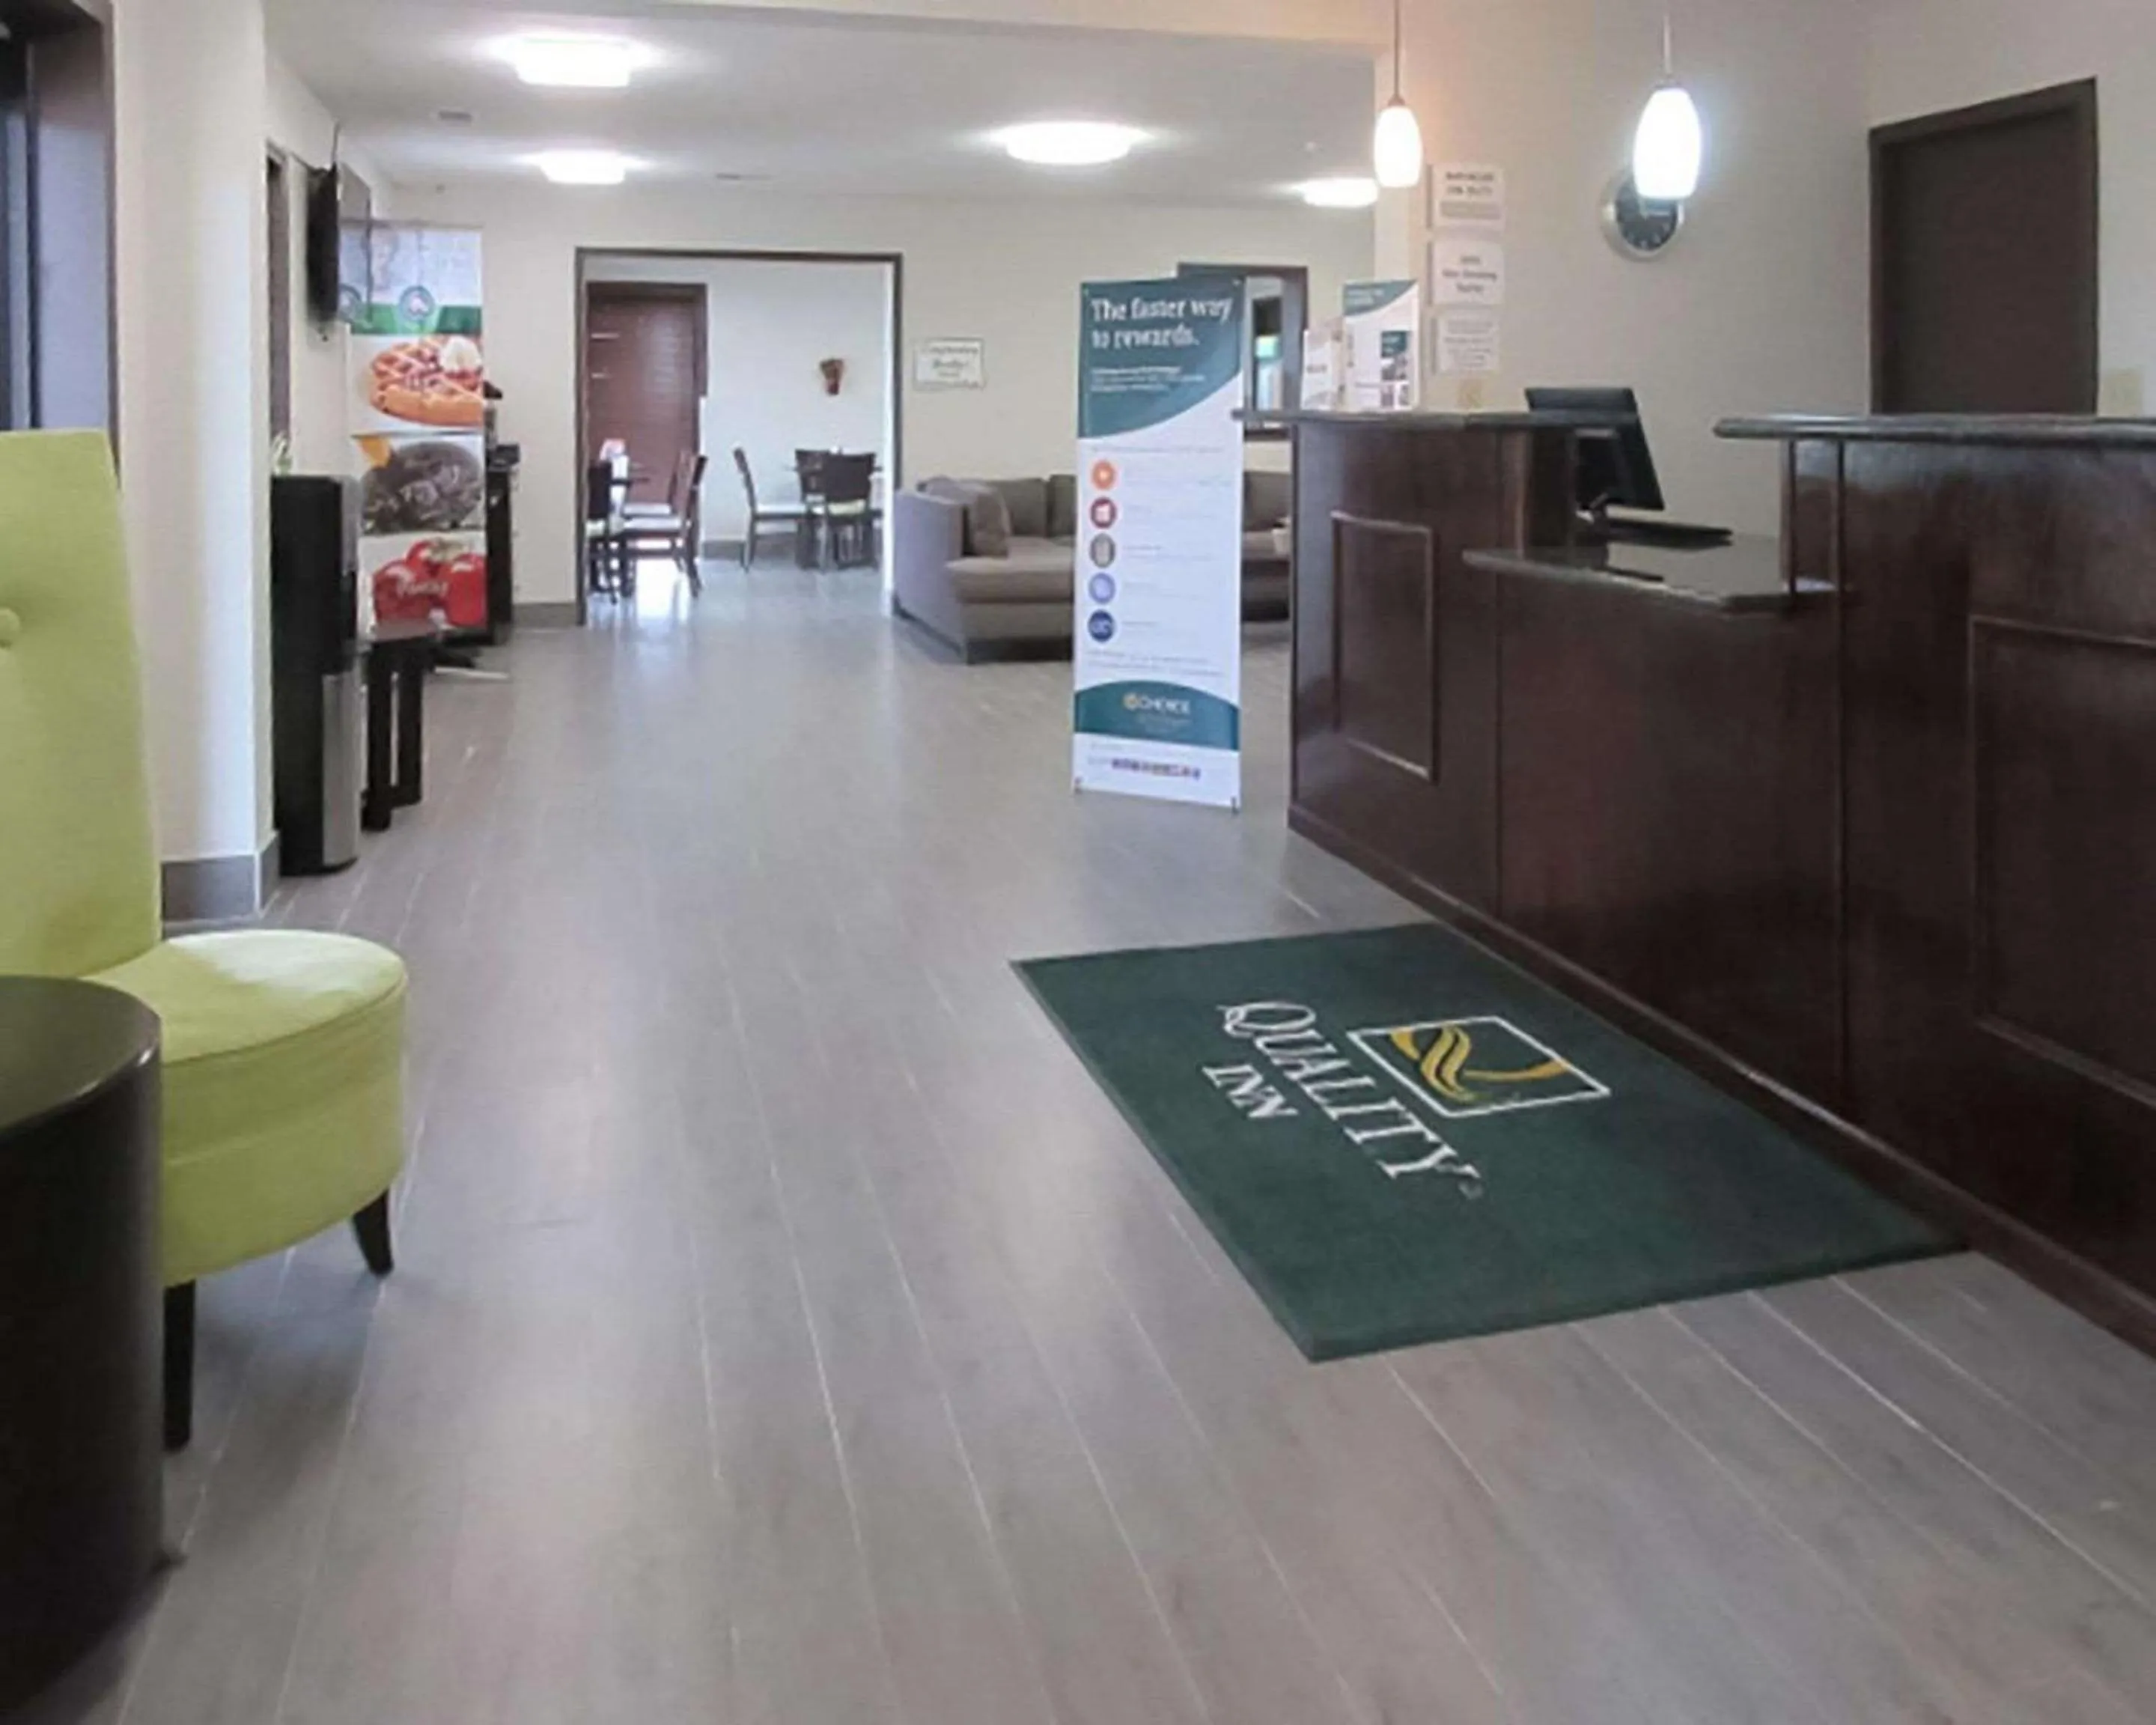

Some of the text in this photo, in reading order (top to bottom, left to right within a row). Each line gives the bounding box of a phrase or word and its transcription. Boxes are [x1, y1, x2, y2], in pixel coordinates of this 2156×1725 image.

[1091, 296, 1233, 325] The faster way
[1091, 327, 1109, 350] to
[1201, 1063, 1299, 1119] INN
[1216, 1000, 1481, 1179] QUALITY
